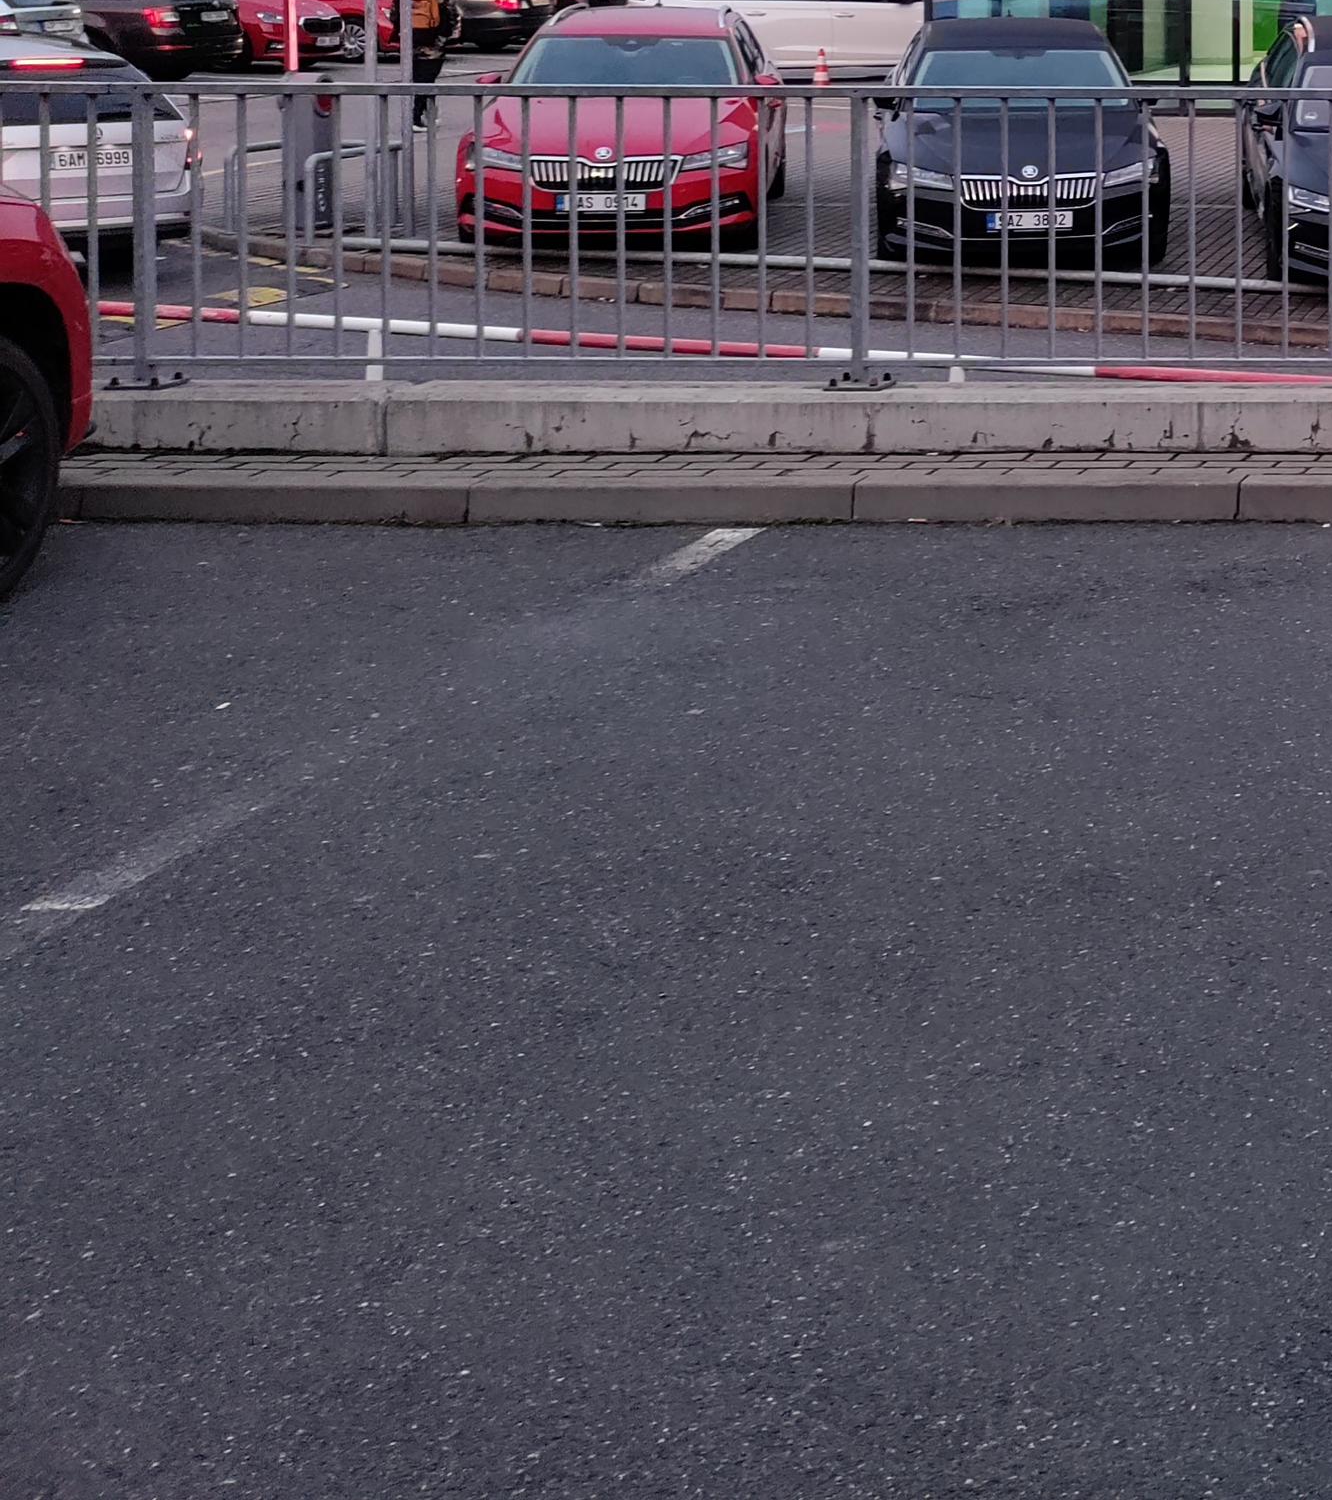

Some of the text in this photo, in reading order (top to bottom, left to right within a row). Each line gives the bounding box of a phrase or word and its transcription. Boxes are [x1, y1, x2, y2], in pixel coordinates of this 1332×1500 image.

[58, 150, 131, 167] 6AM 6999
[568, 196, 594, 209] AS
